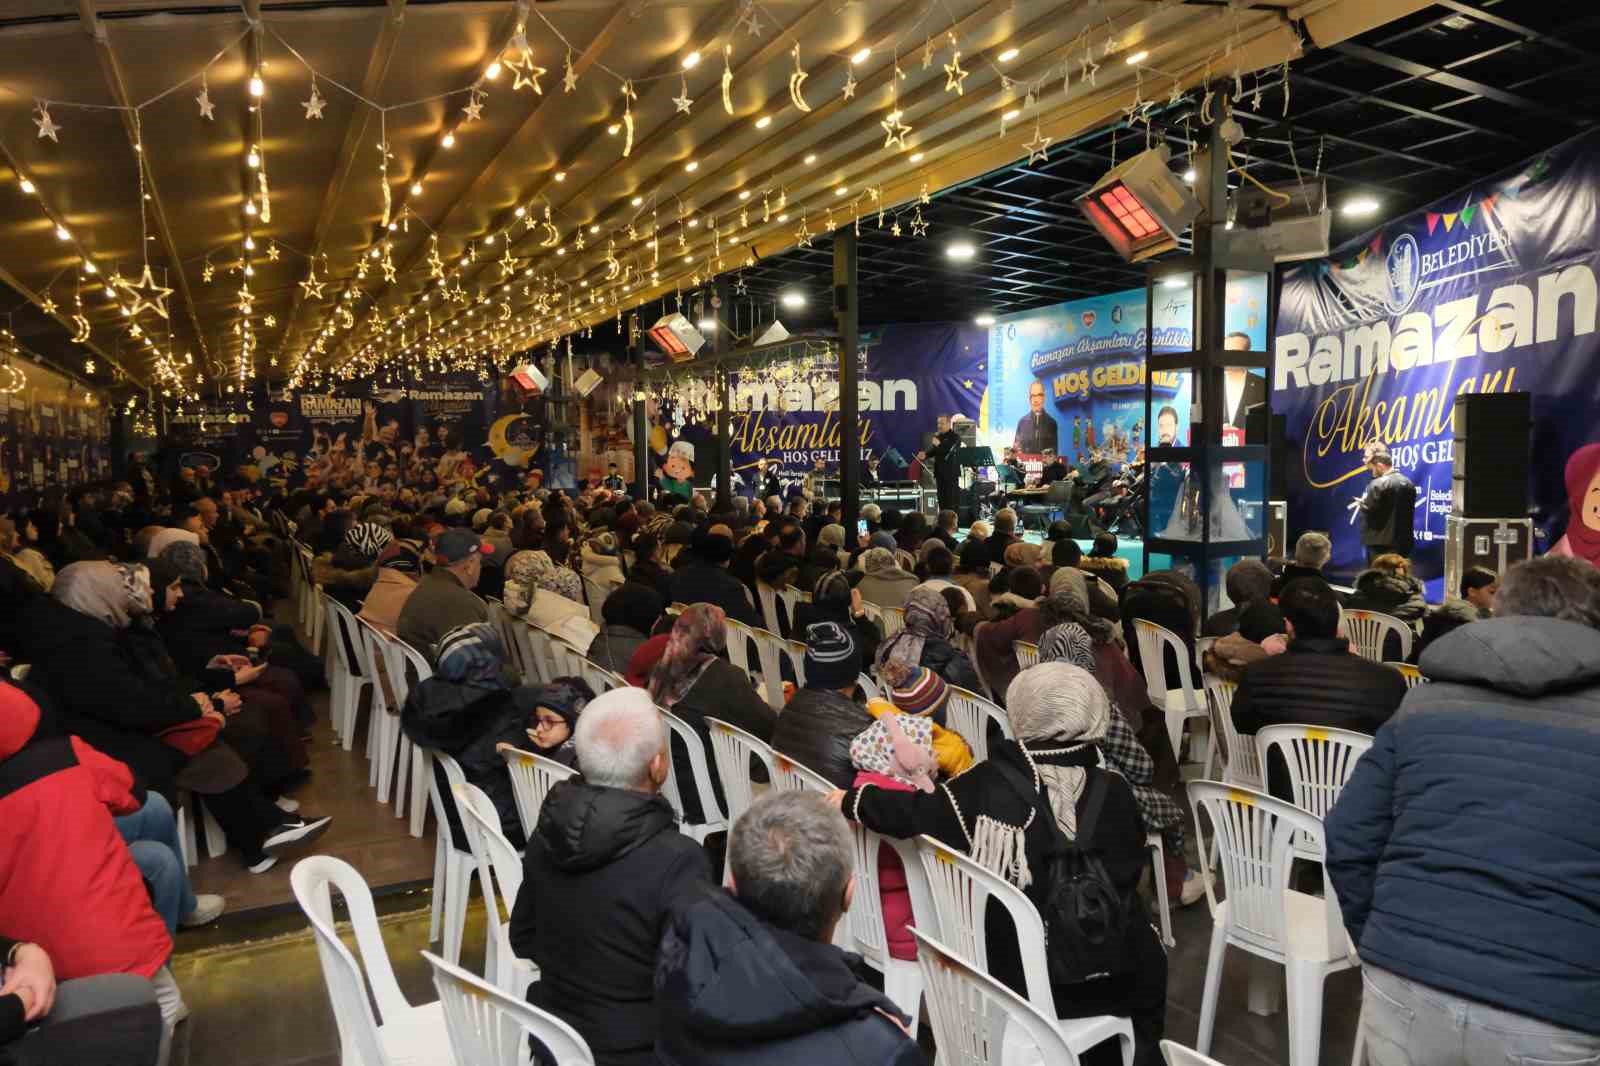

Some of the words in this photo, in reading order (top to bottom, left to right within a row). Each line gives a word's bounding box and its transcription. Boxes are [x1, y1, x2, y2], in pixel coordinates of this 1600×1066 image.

[1274, 265, 1597, 390] Ramazan
[1054, 370, 1090, 397] HOŞ
[731, 405, 875, 456] Akşamlaı
[783, 450, 809, 464] HOŞ
[1391, 444, 1420, 471] HOŞ
[1422, 439, 1454, 464] GEL
